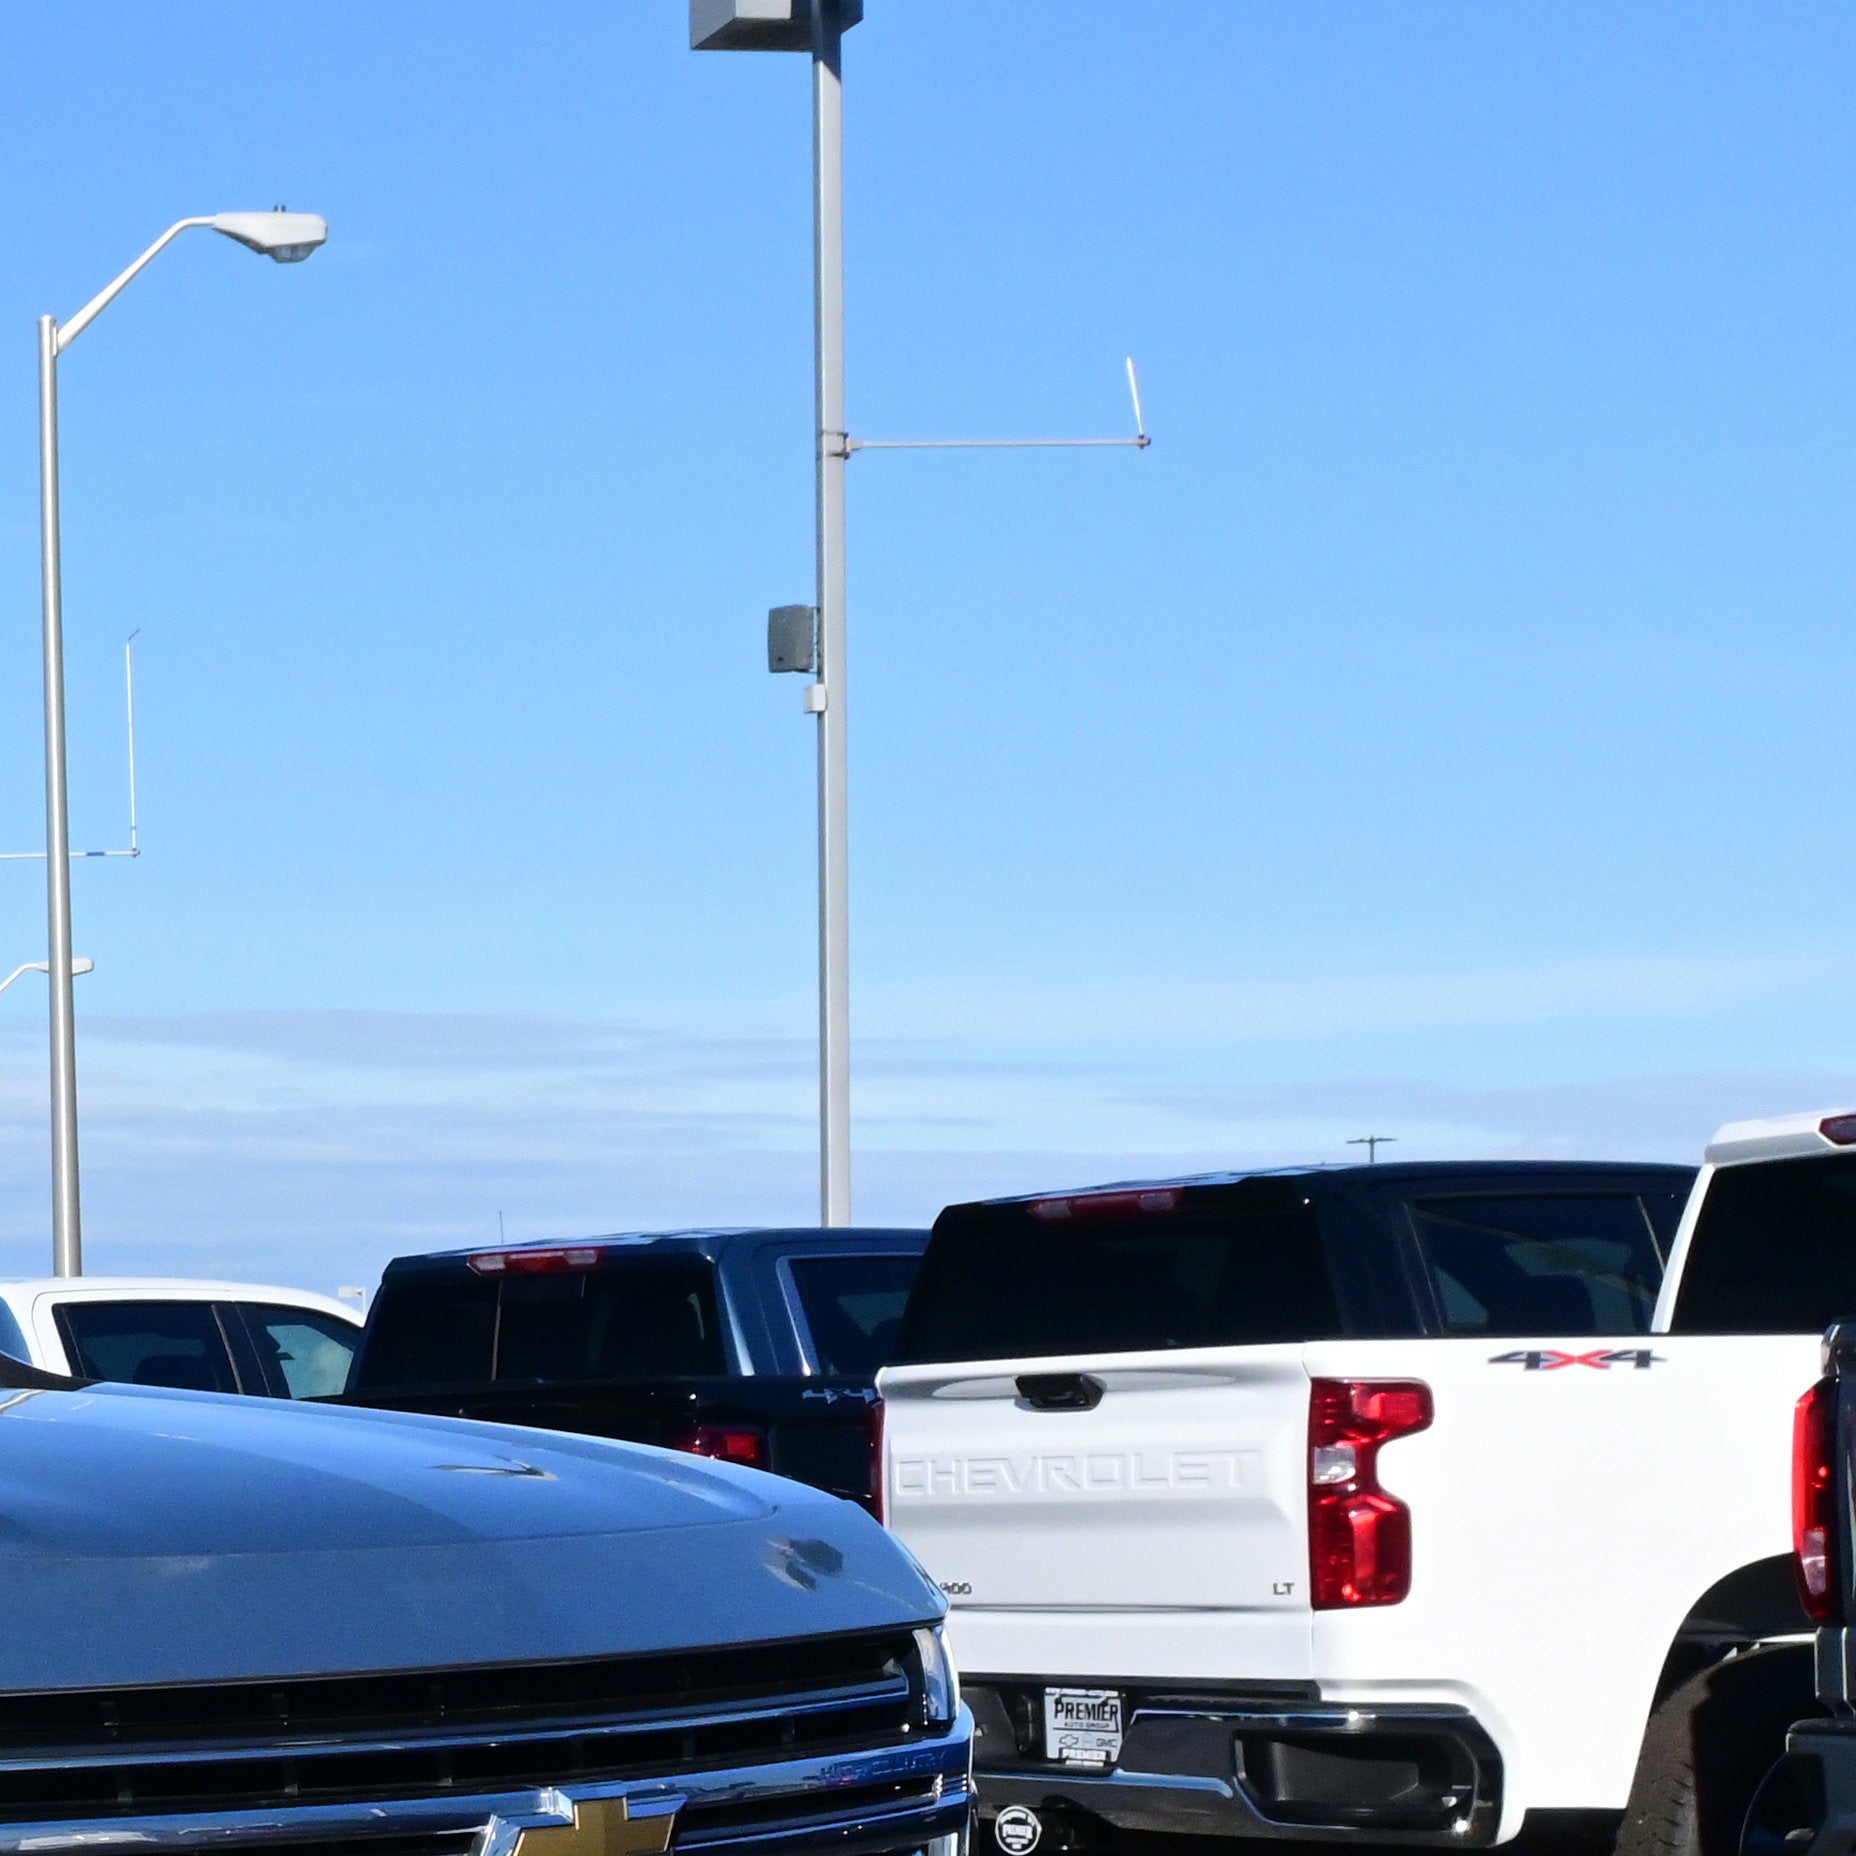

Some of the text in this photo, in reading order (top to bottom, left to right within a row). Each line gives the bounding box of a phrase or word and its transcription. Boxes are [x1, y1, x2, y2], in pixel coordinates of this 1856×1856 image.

[895, 1448, 1262, 1496] CHEVROLET
[1273, 1582, 1295, 1595] LT
[1054, 1701, 1119, 1721] PREMIER
